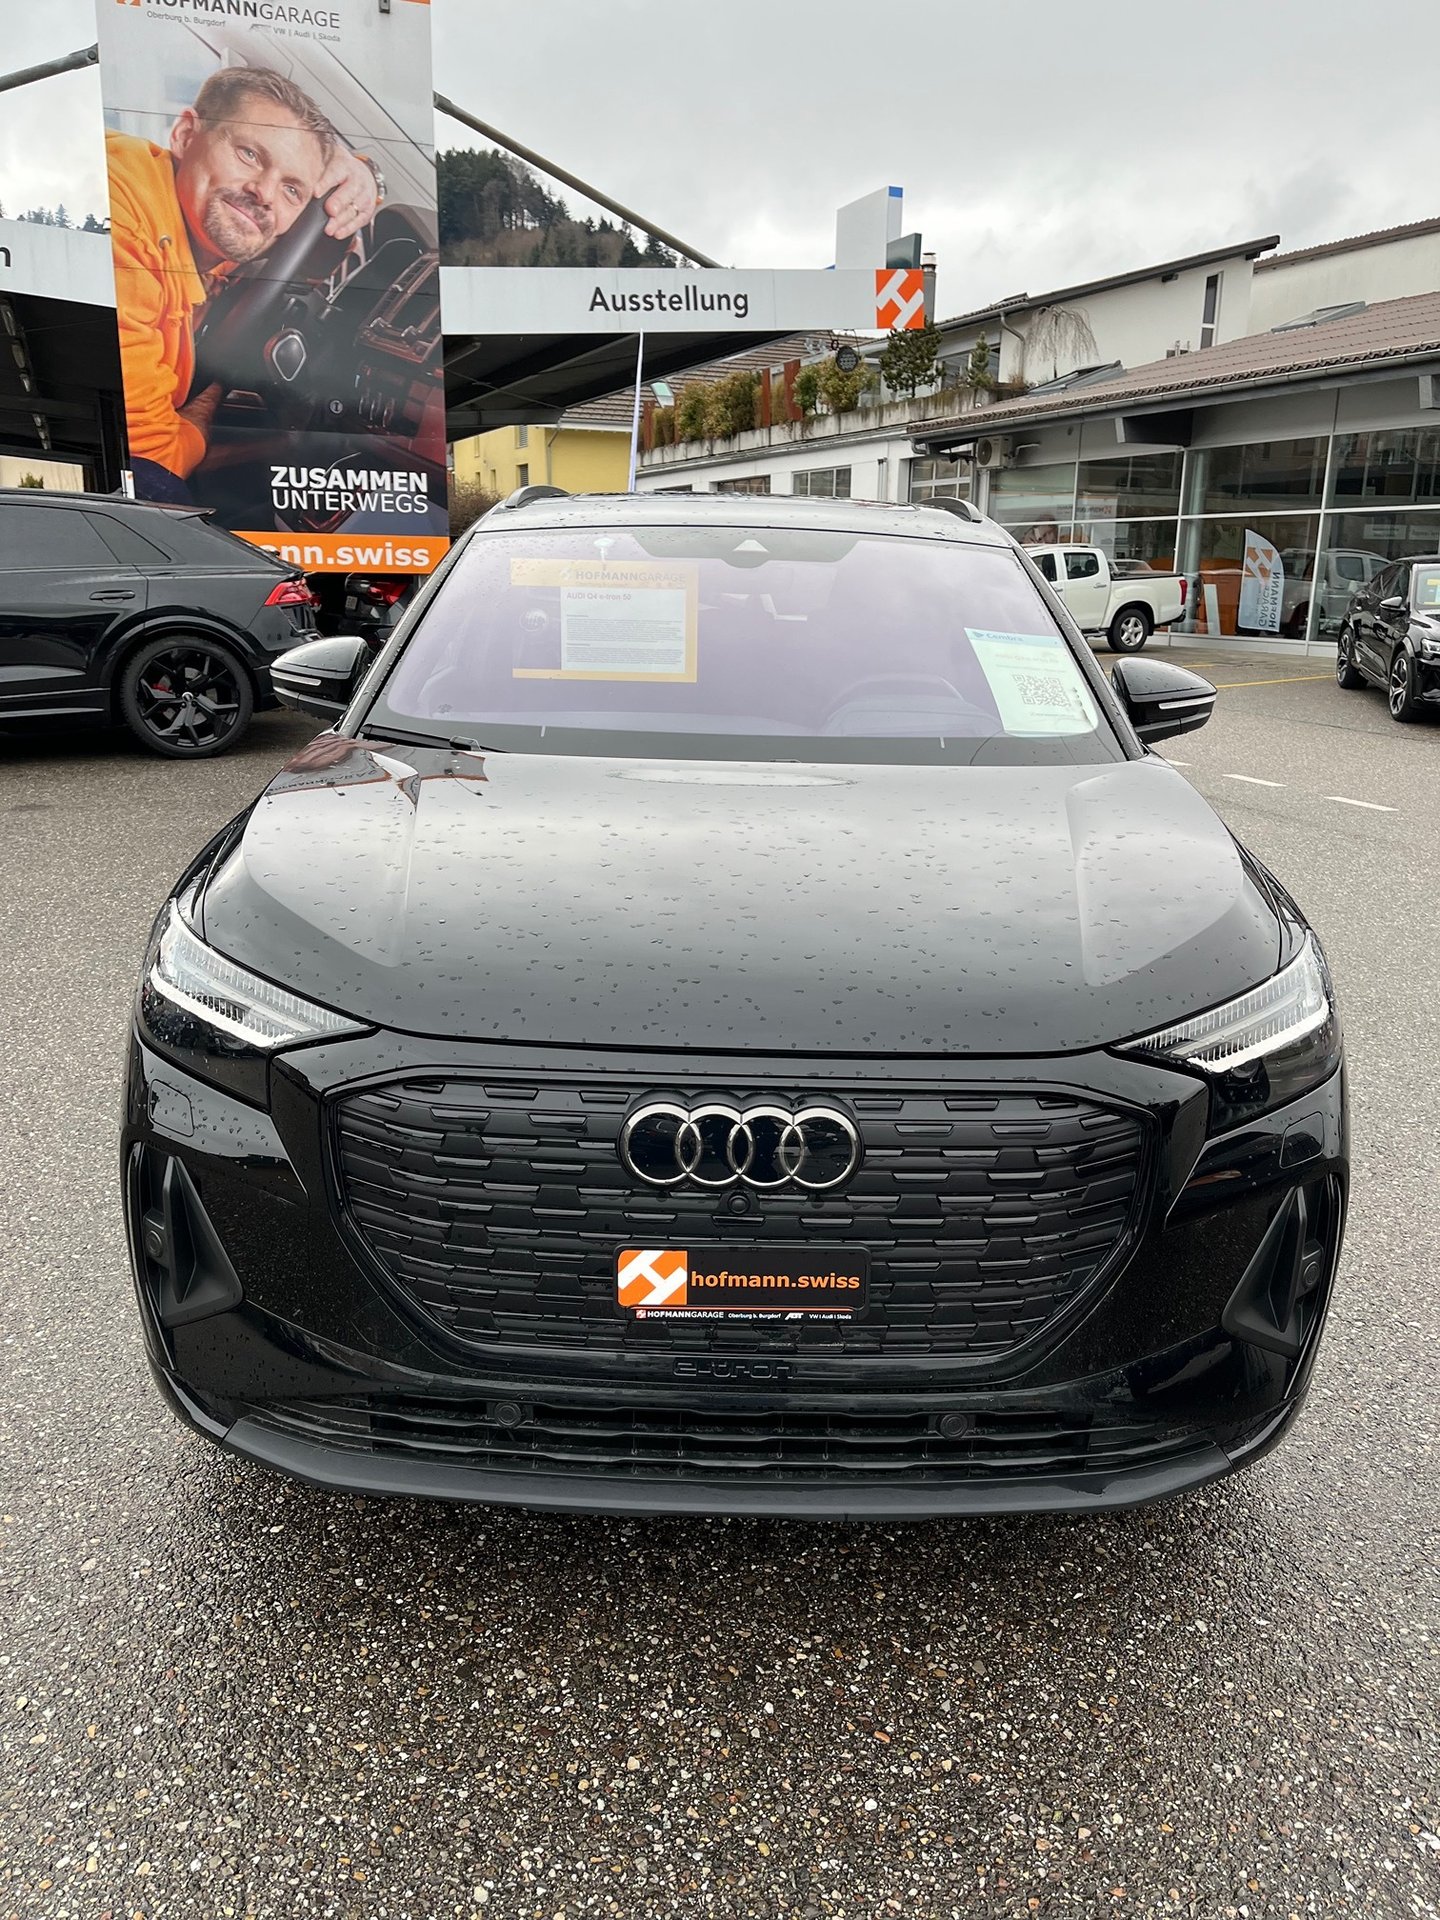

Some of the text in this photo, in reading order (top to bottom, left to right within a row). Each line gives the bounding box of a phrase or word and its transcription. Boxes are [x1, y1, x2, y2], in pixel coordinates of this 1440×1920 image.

[147, 10, 182, 24] Oberburg
[194, 16, 225, 28] Burgdorf
[294, 30, 310, 38] Audi
[588, 284, 749, 318] Ausstellung
[270, 465, 428, 493] ZUSAMMEN
[272, 489, 428, 514] UNTERWEGS
[575, 570, 686, 582] HOFMANNGARAGE
[691, 1271, 860, 1289] hofmann.swiss
[647, 1311, 724, 1319] HOFMANNGARAGE
[673, 1360, 795, 1379] e-tron
